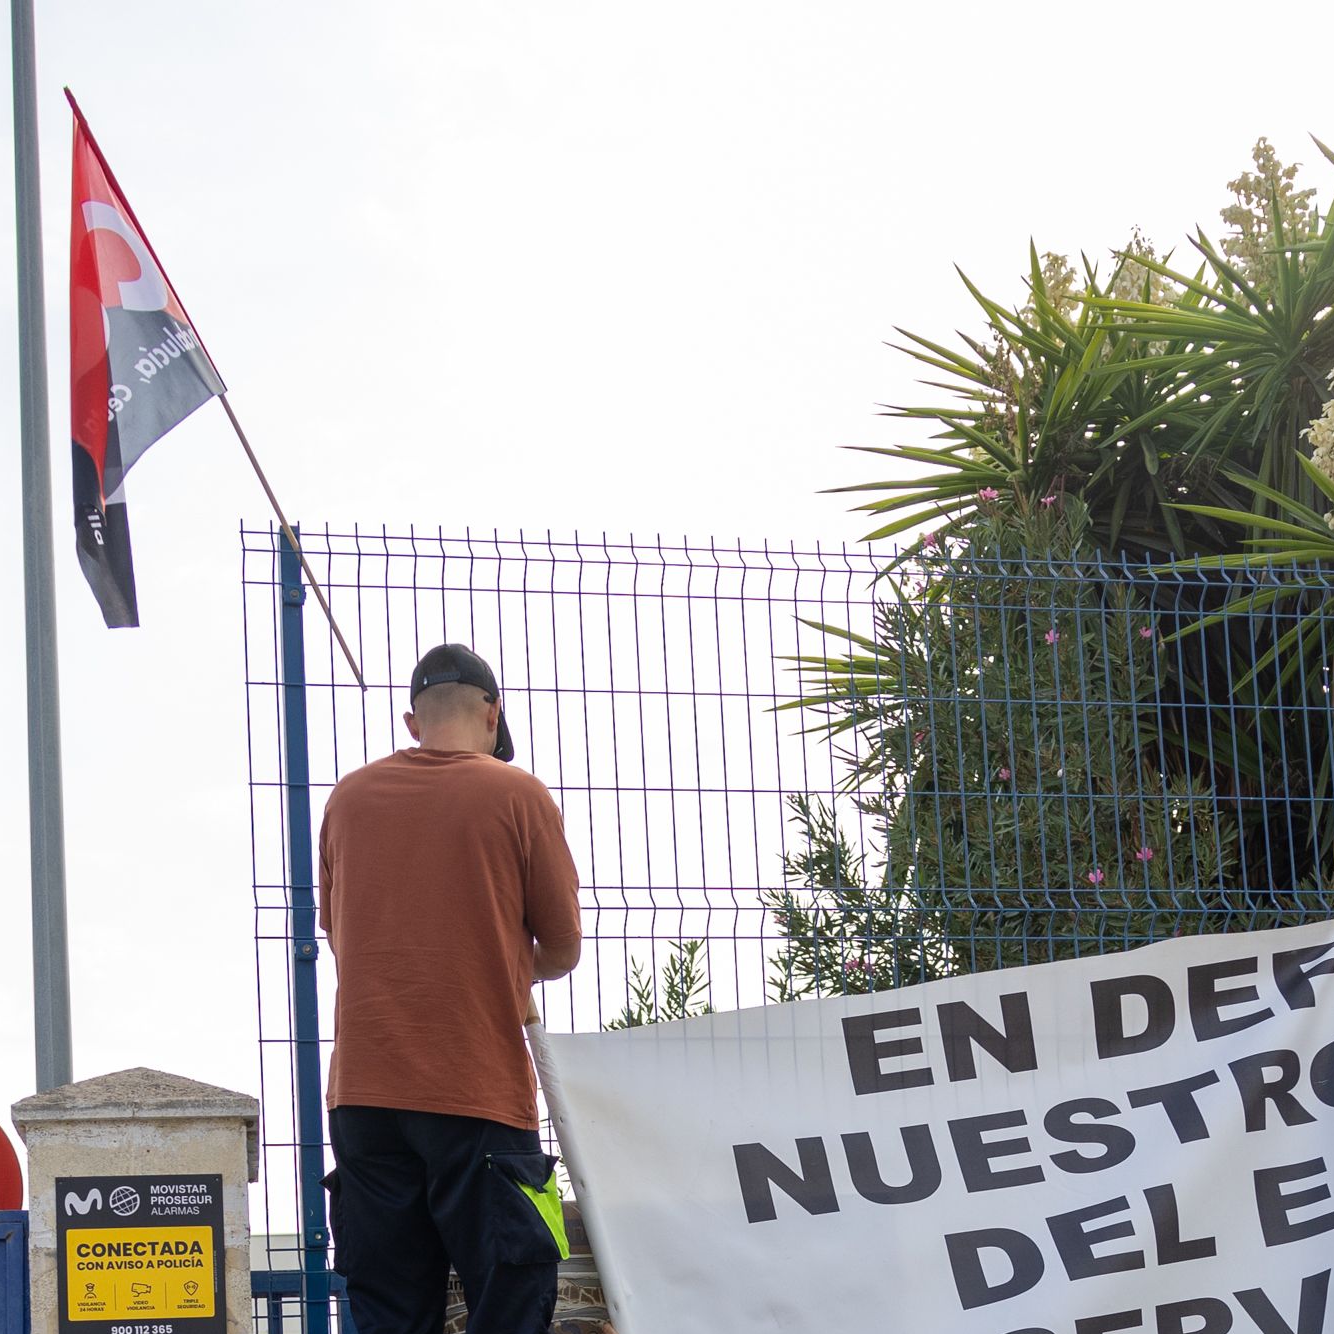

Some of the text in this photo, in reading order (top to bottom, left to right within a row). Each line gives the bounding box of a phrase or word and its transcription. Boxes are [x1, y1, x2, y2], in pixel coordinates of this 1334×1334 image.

[841, 991, 1038, 1096] EN
[150, 1184, 208, 1195] MOVISTAR
[150, 1194, 213, 1206] PROSEGUR
[150, 1206, 200, 1216] ALARMAS
[76, 1240, 204, 1258] CONECTADA
[943, 1182, 1217, 1312] DEL
[76, 1255, 204, 1271] CON AVISO A POLICÍA
[134, 1325, 150, 1334] 112
[151, 1324, 173, 1334] 365
